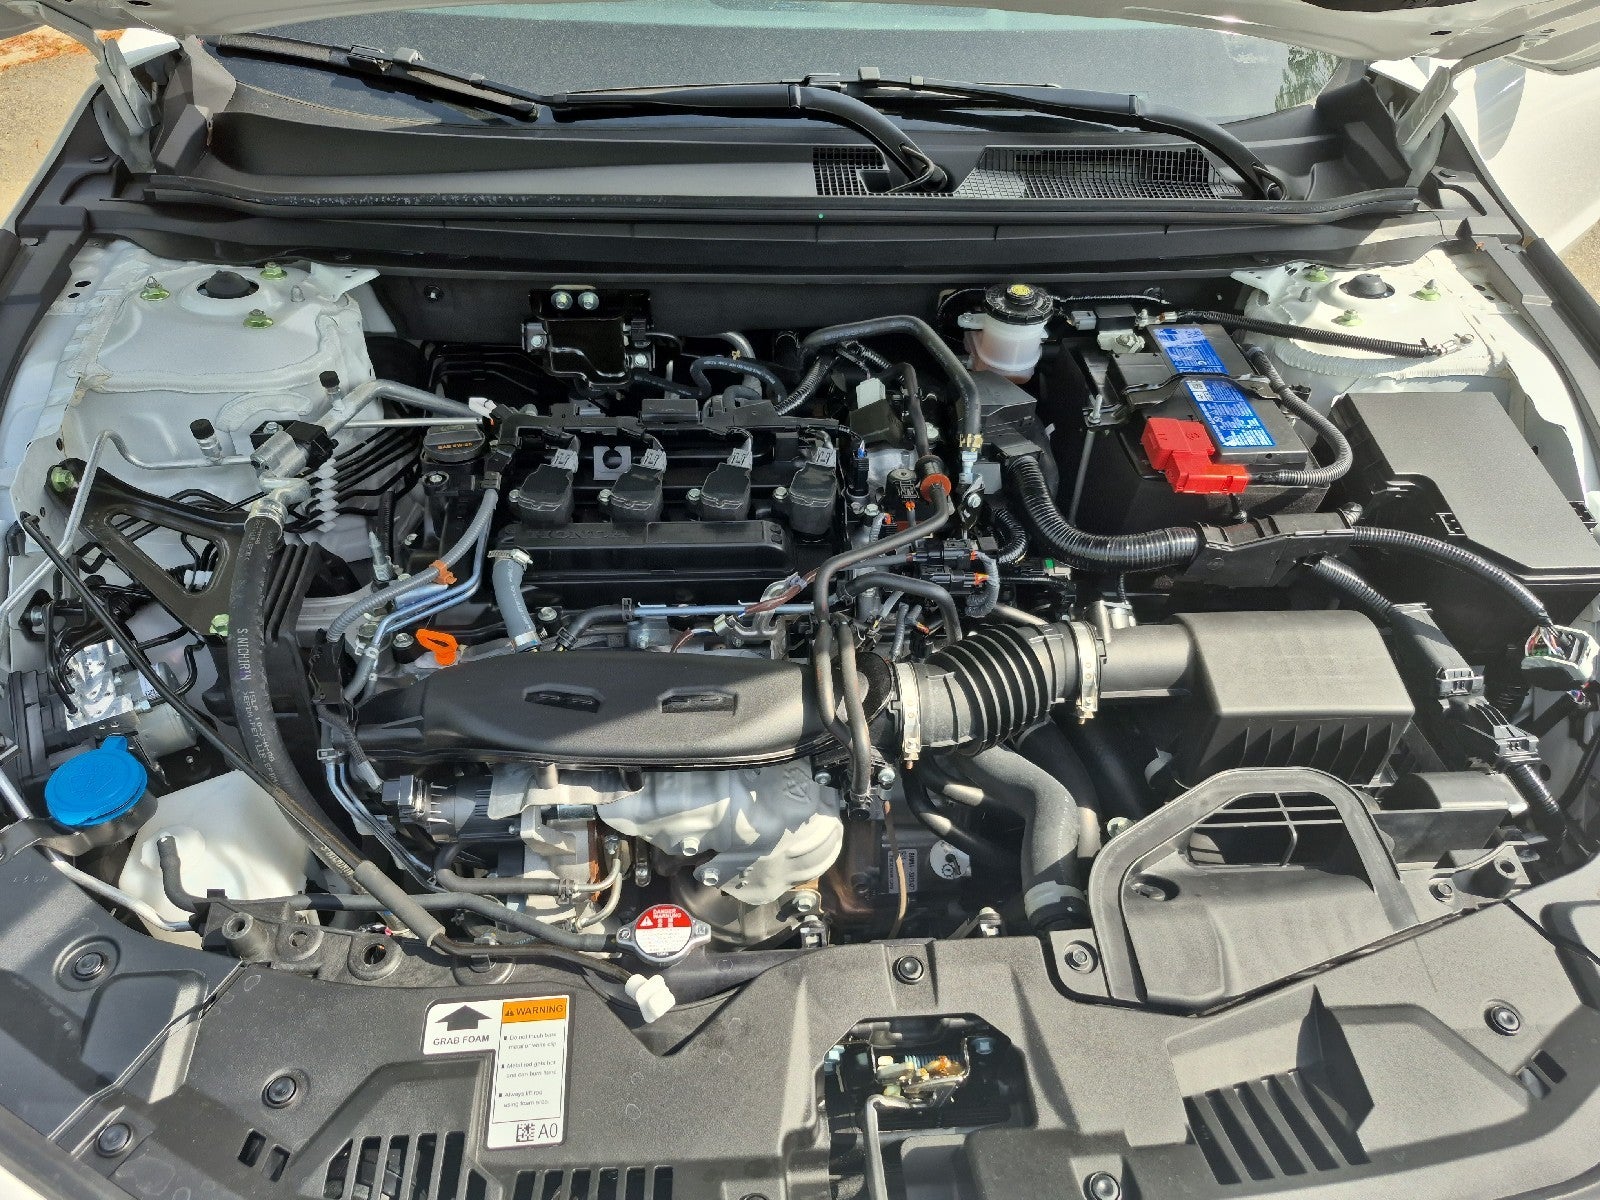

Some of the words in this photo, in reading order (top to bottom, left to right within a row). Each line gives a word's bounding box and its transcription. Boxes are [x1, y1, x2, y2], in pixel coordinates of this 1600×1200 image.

[527, 529, 631, 541] HONDA
[516, 1004, 564, 1016] WARNING
[433, 1036, 460, 1046] GRAB
[462, 1034, 490, 1044] FOAM
